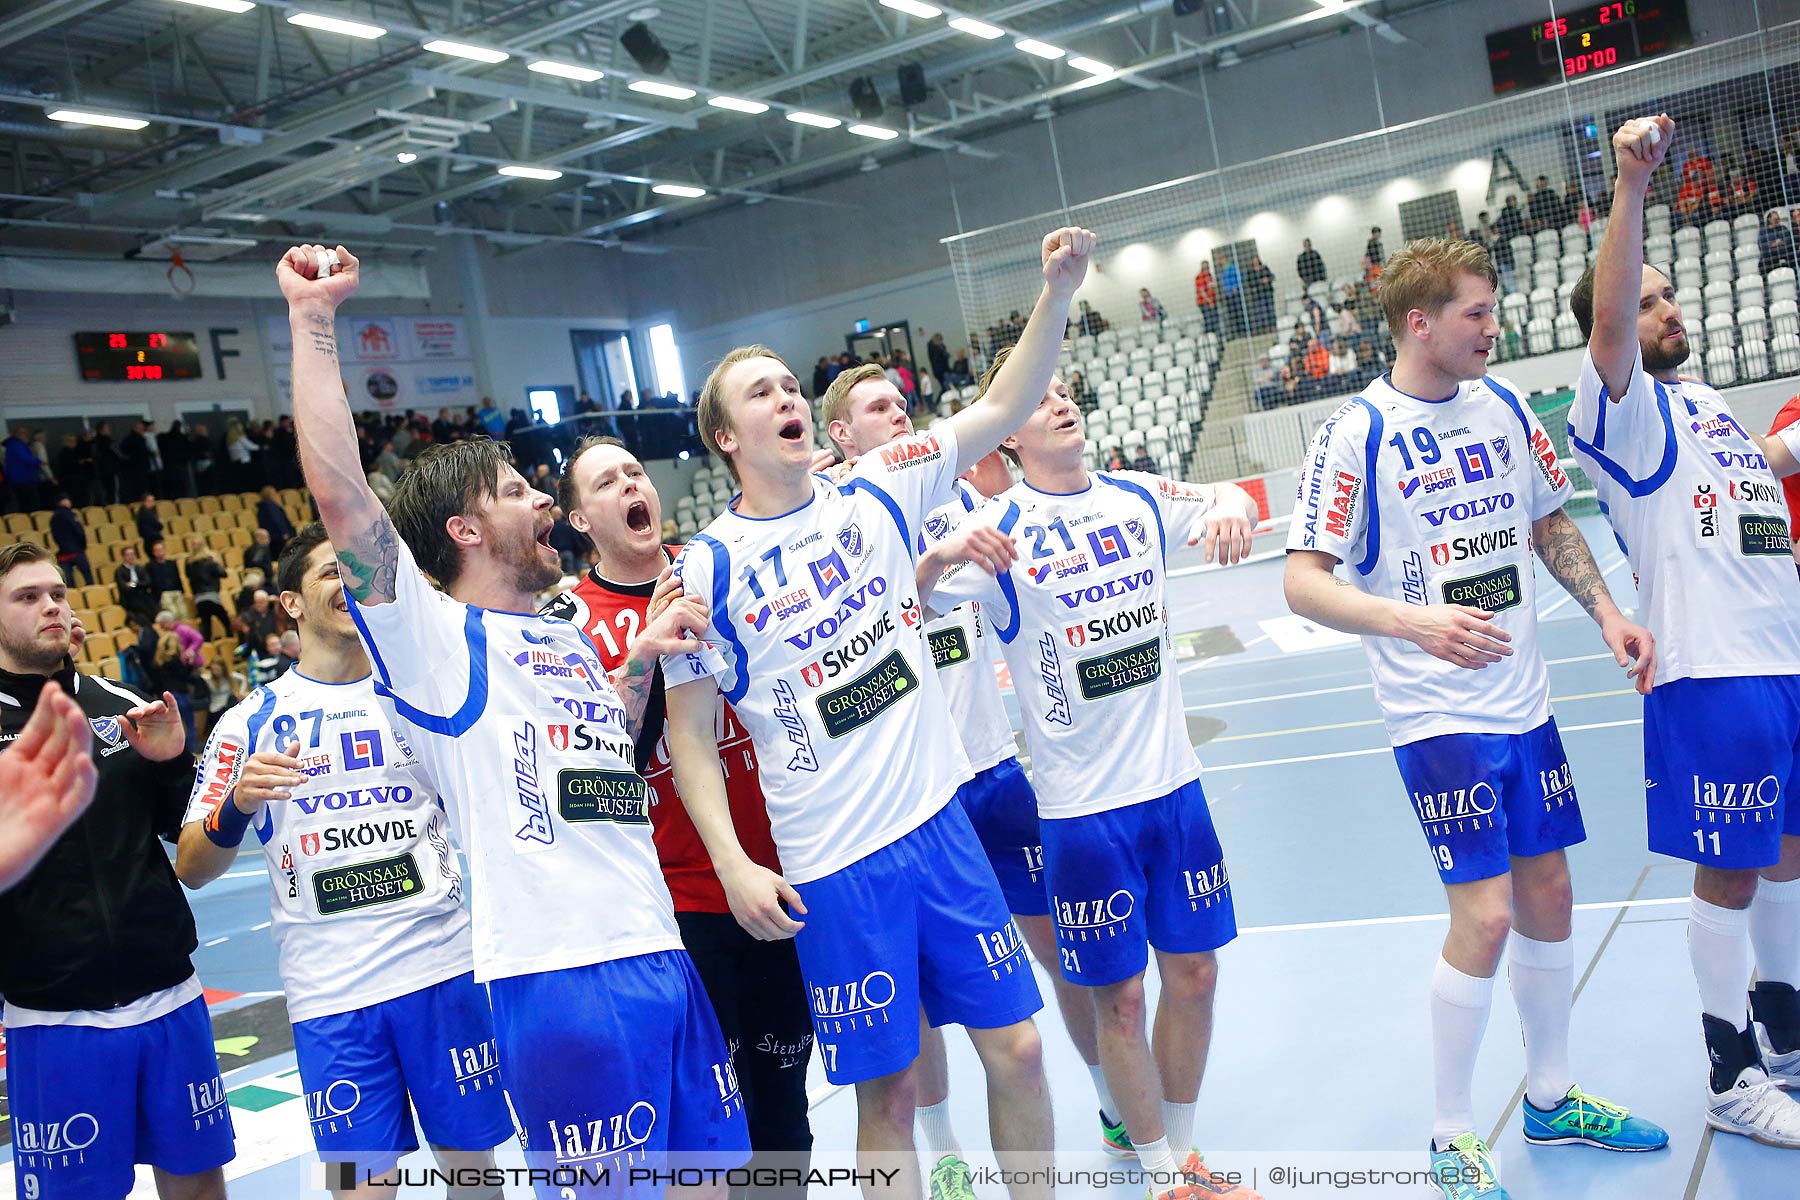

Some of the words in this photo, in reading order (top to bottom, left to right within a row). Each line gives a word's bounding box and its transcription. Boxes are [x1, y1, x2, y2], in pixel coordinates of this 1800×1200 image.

[1600, 3, 1623, 25] 27
[1625, 1, 1636, 15] G
[1544, 18, 1568, 40] 25
[1581, 33, 1591, 48] 2
[208, 328, 240, 380] F
[880, 436, 940, 466] MAXI
[1389, 426, 1442, 471] 19
[1530, 428, 1567, 489] MAXI
[1421, 467, 1455, 484] INTER
[1424, 477, 1457, 494] SPORT
[1325, 471, 1355, 537] MAXI
[1345, 477, 1362, 528] STORMARKNAD
[1420, 493, 1515, 527] VOLVO
[1024, 516, 1076, 560] 21
[1452, 527, 1518, 561] SKÖVDE
[738, 545, 788, 599] 17
[1052, 553, 1087, 571] INTER
[1055, 562, 1090, 579] SPORT
[770, 588, 809, 611] INTER
[1056, 569, 1154, 609] VOLVO
[1451, 573, 1512, 601] GRÖNSAKS
[776, 598, 813, 621] SPORT
[784, 576, 887, 650] VOLVO
[1087, 602, 1158, 642] SKÖVDE
[591, 608, 641, 658] 12
[821, 610, 895, 678] SKÖVDE
[533, 663, 573, 678] SPORT
[1085, 646, 1160, 680] GRÖNSAKS
[1110, 663, 1156, 688] HUSET
[827, 660, 900, 716] GRÖNSAKS
[855, 681, 898, 720] HUSET
[272, 708, 324, 753] 87
[201, 741, 238, 805] MAXI
[292, 785, 413, 815] VOLVO
[596, 797, 643, 816] HUSET
[324, 819, 417, 851] SKÖVDE
[1692, 829, 1721, 856] 11
[1431, 844, 1454, 871] 19
[321, 862, 409, 893] GRÖNSAKS
[349, 880, 404, 903] HUSET
[1061, 947, 1082, 974] 21
[23, 1173, 40, 1200] 9
